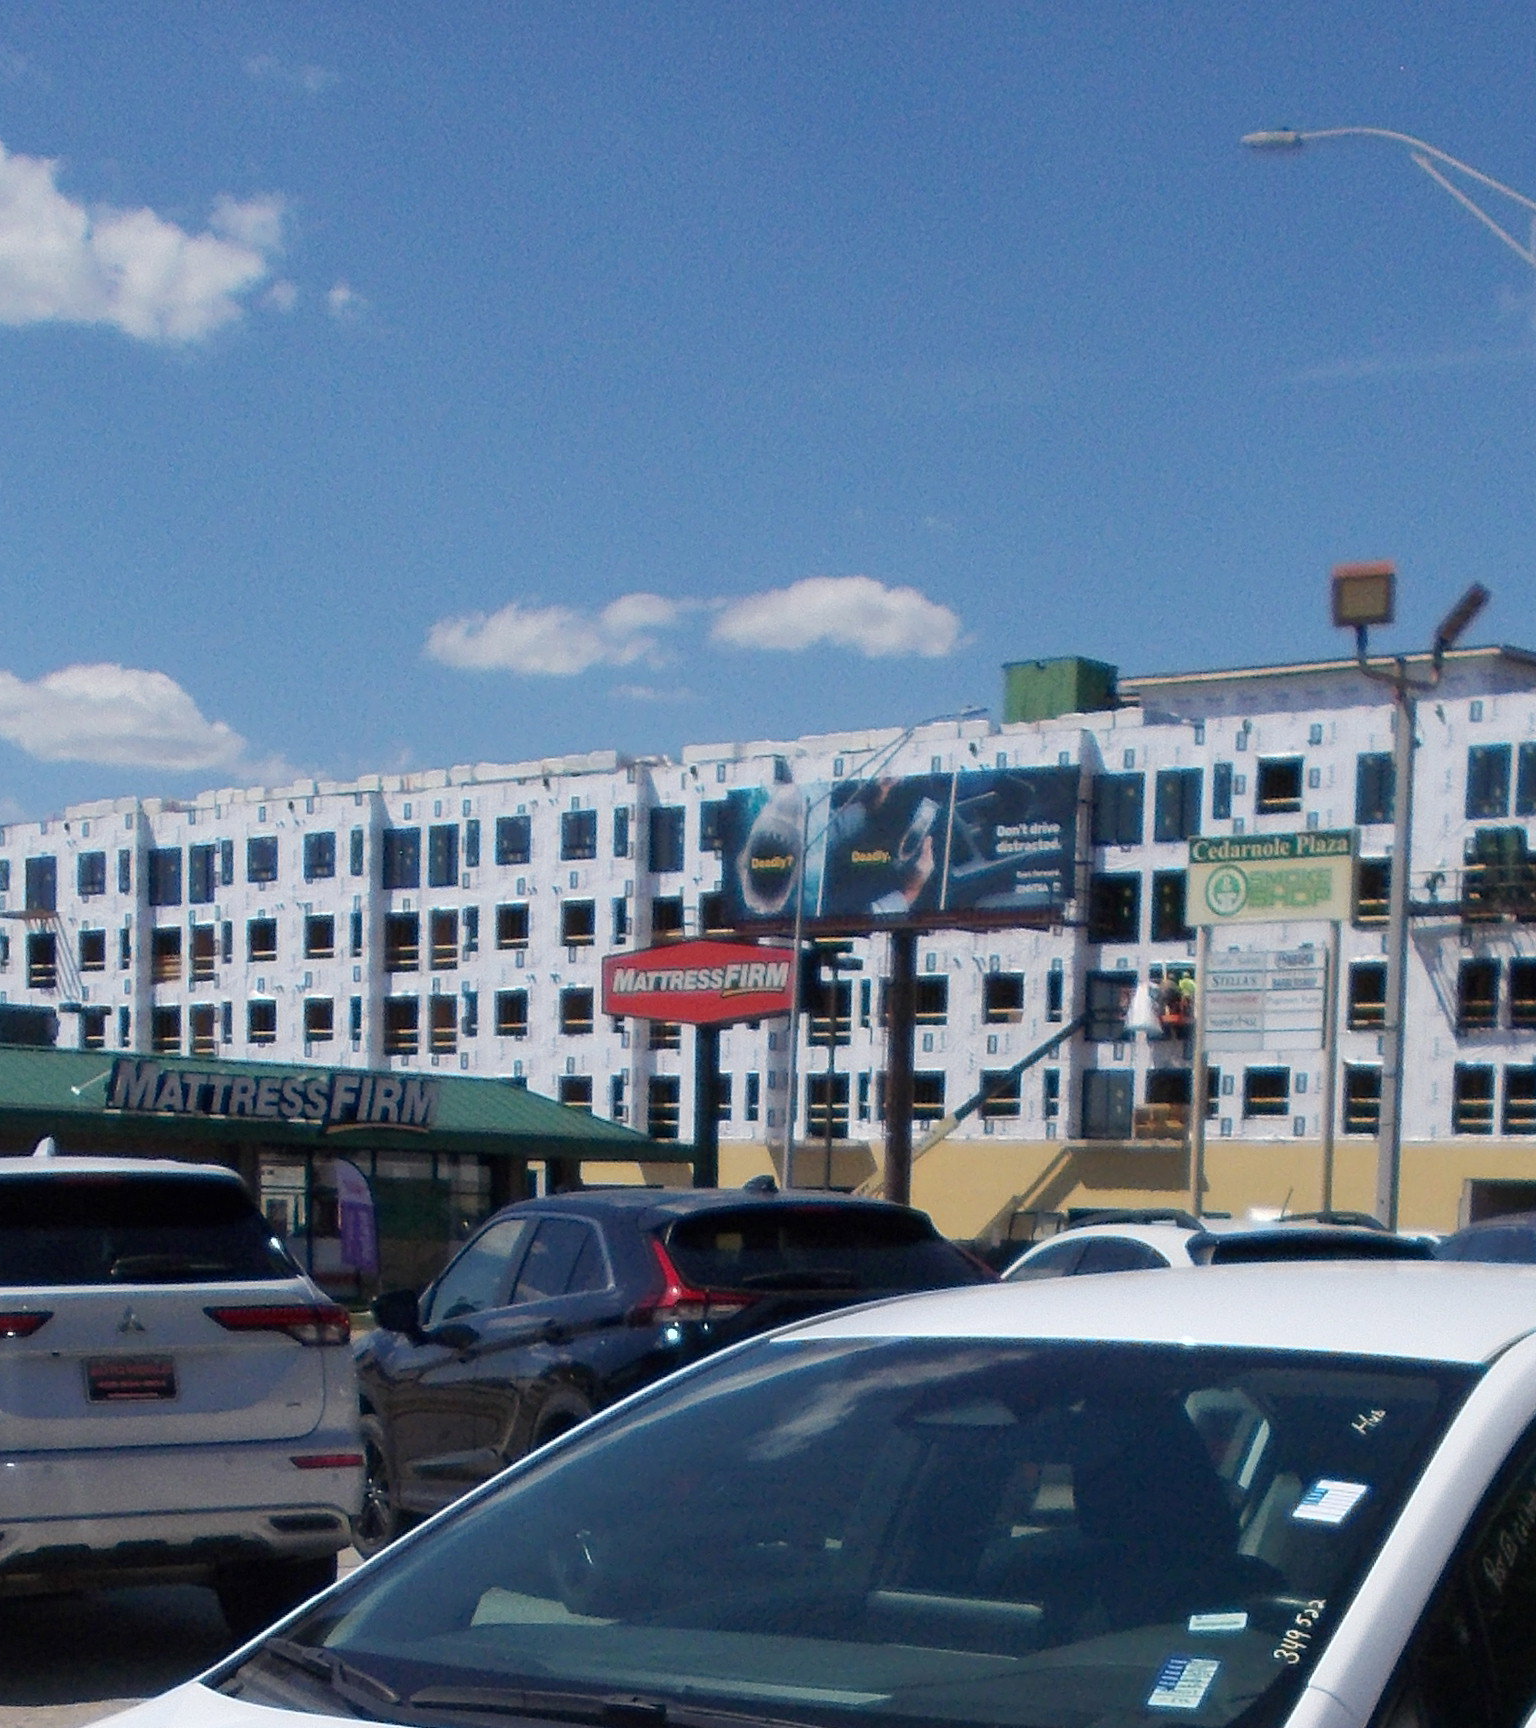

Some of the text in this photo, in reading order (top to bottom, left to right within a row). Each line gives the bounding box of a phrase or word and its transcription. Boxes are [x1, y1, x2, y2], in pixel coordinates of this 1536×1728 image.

[996, 821, 1061, 837] Don't drive
[1297, 834, 1349, 854] Plaza
[751, 854, 794, 869] Deadly?
